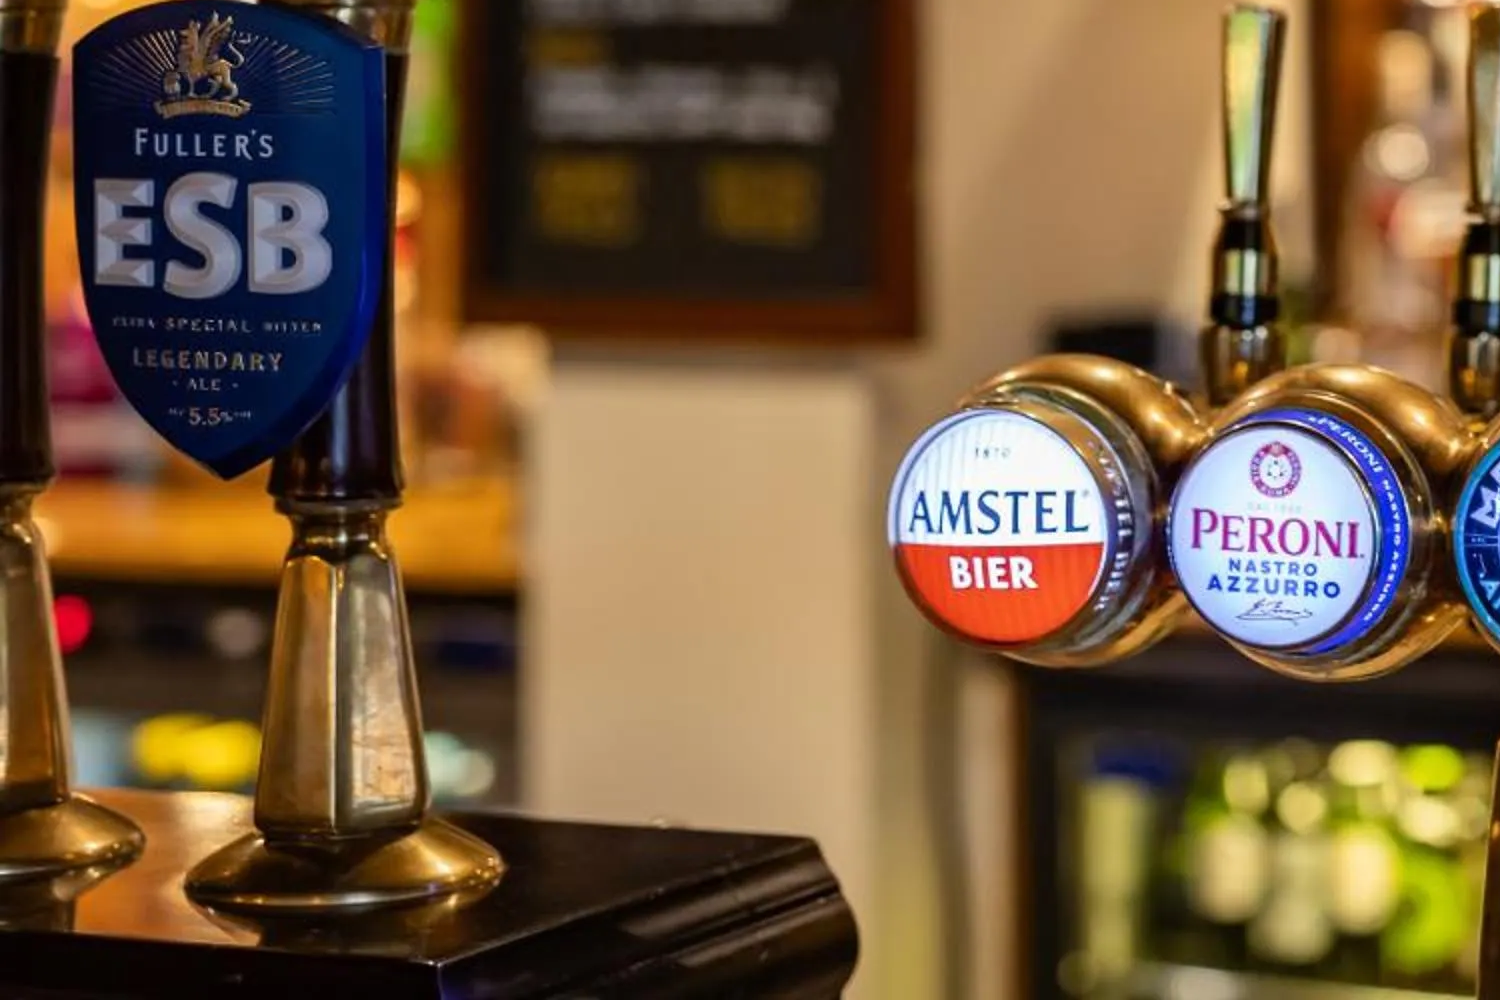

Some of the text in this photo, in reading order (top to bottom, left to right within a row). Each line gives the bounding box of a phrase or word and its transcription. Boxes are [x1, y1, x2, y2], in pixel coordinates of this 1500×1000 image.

[134, 127, 274, 161] FULLER'S
[93, 171, 334, 300] ESB
[164, 317, 252, 334] SPECIAL
[133, 346, 283, 373] LEGENDARY
[187, 378, 222, 392] ALE
[908, 489, 1090, 536] AMSTEL
[1191, 507, 1360, 560] PERONI
[948, 555, 1039, 590] BIER
[1228, 558, 1318, 578] NASTRO
[1206, 575, 1341, 599] AZZURRO
